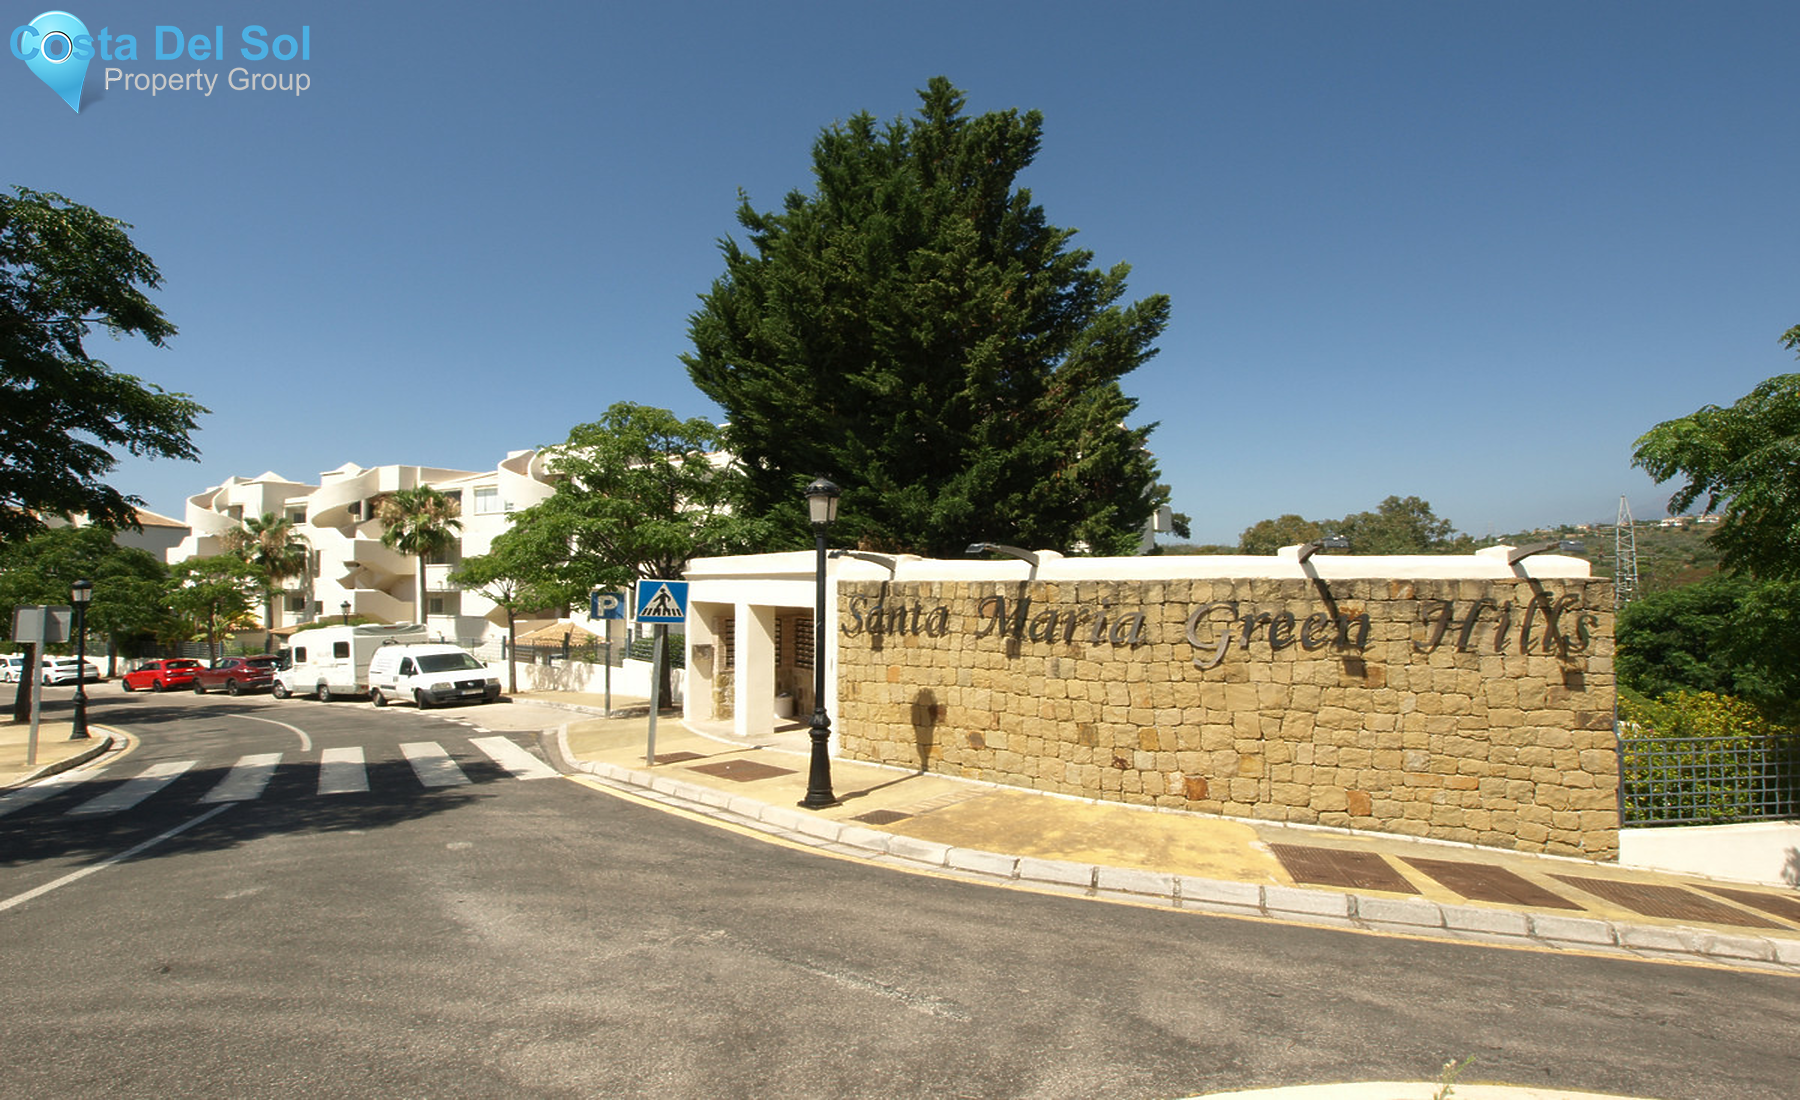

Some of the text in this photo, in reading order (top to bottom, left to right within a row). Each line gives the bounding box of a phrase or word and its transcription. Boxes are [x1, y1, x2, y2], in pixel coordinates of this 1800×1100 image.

[598, 595, 618, 616] P
[841, 591, 1599, 669] Santa Maria Green Hills
